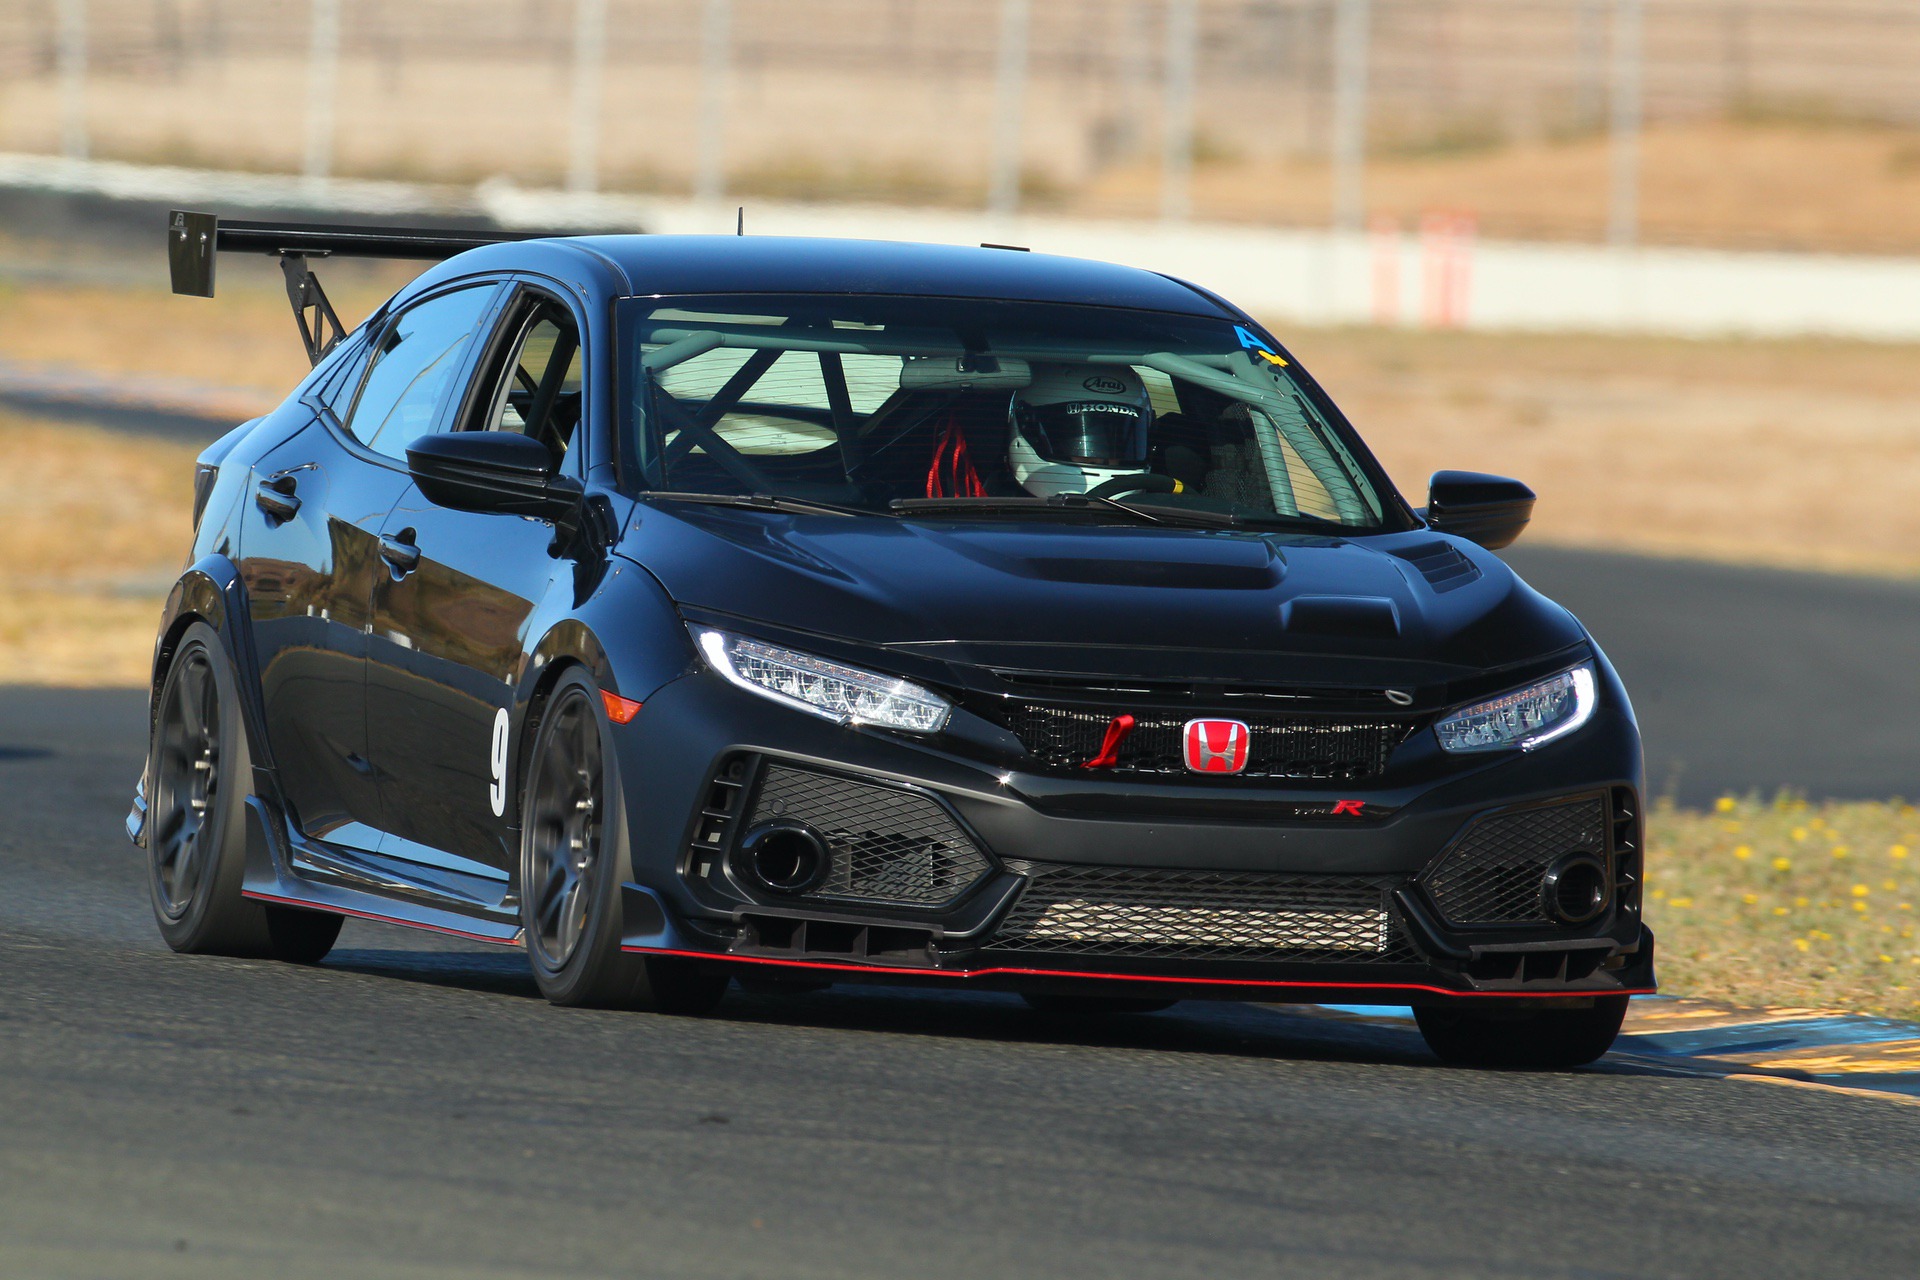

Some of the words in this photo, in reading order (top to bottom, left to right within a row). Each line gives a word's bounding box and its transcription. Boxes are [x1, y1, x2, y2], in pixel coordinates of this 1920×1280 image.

[1087, 377, 1122, 390] Arai
[1081, 403, 1139, 418] HONDA
[489, 707, 509, 817] 9
[1332, 799, 1365, 816] R
